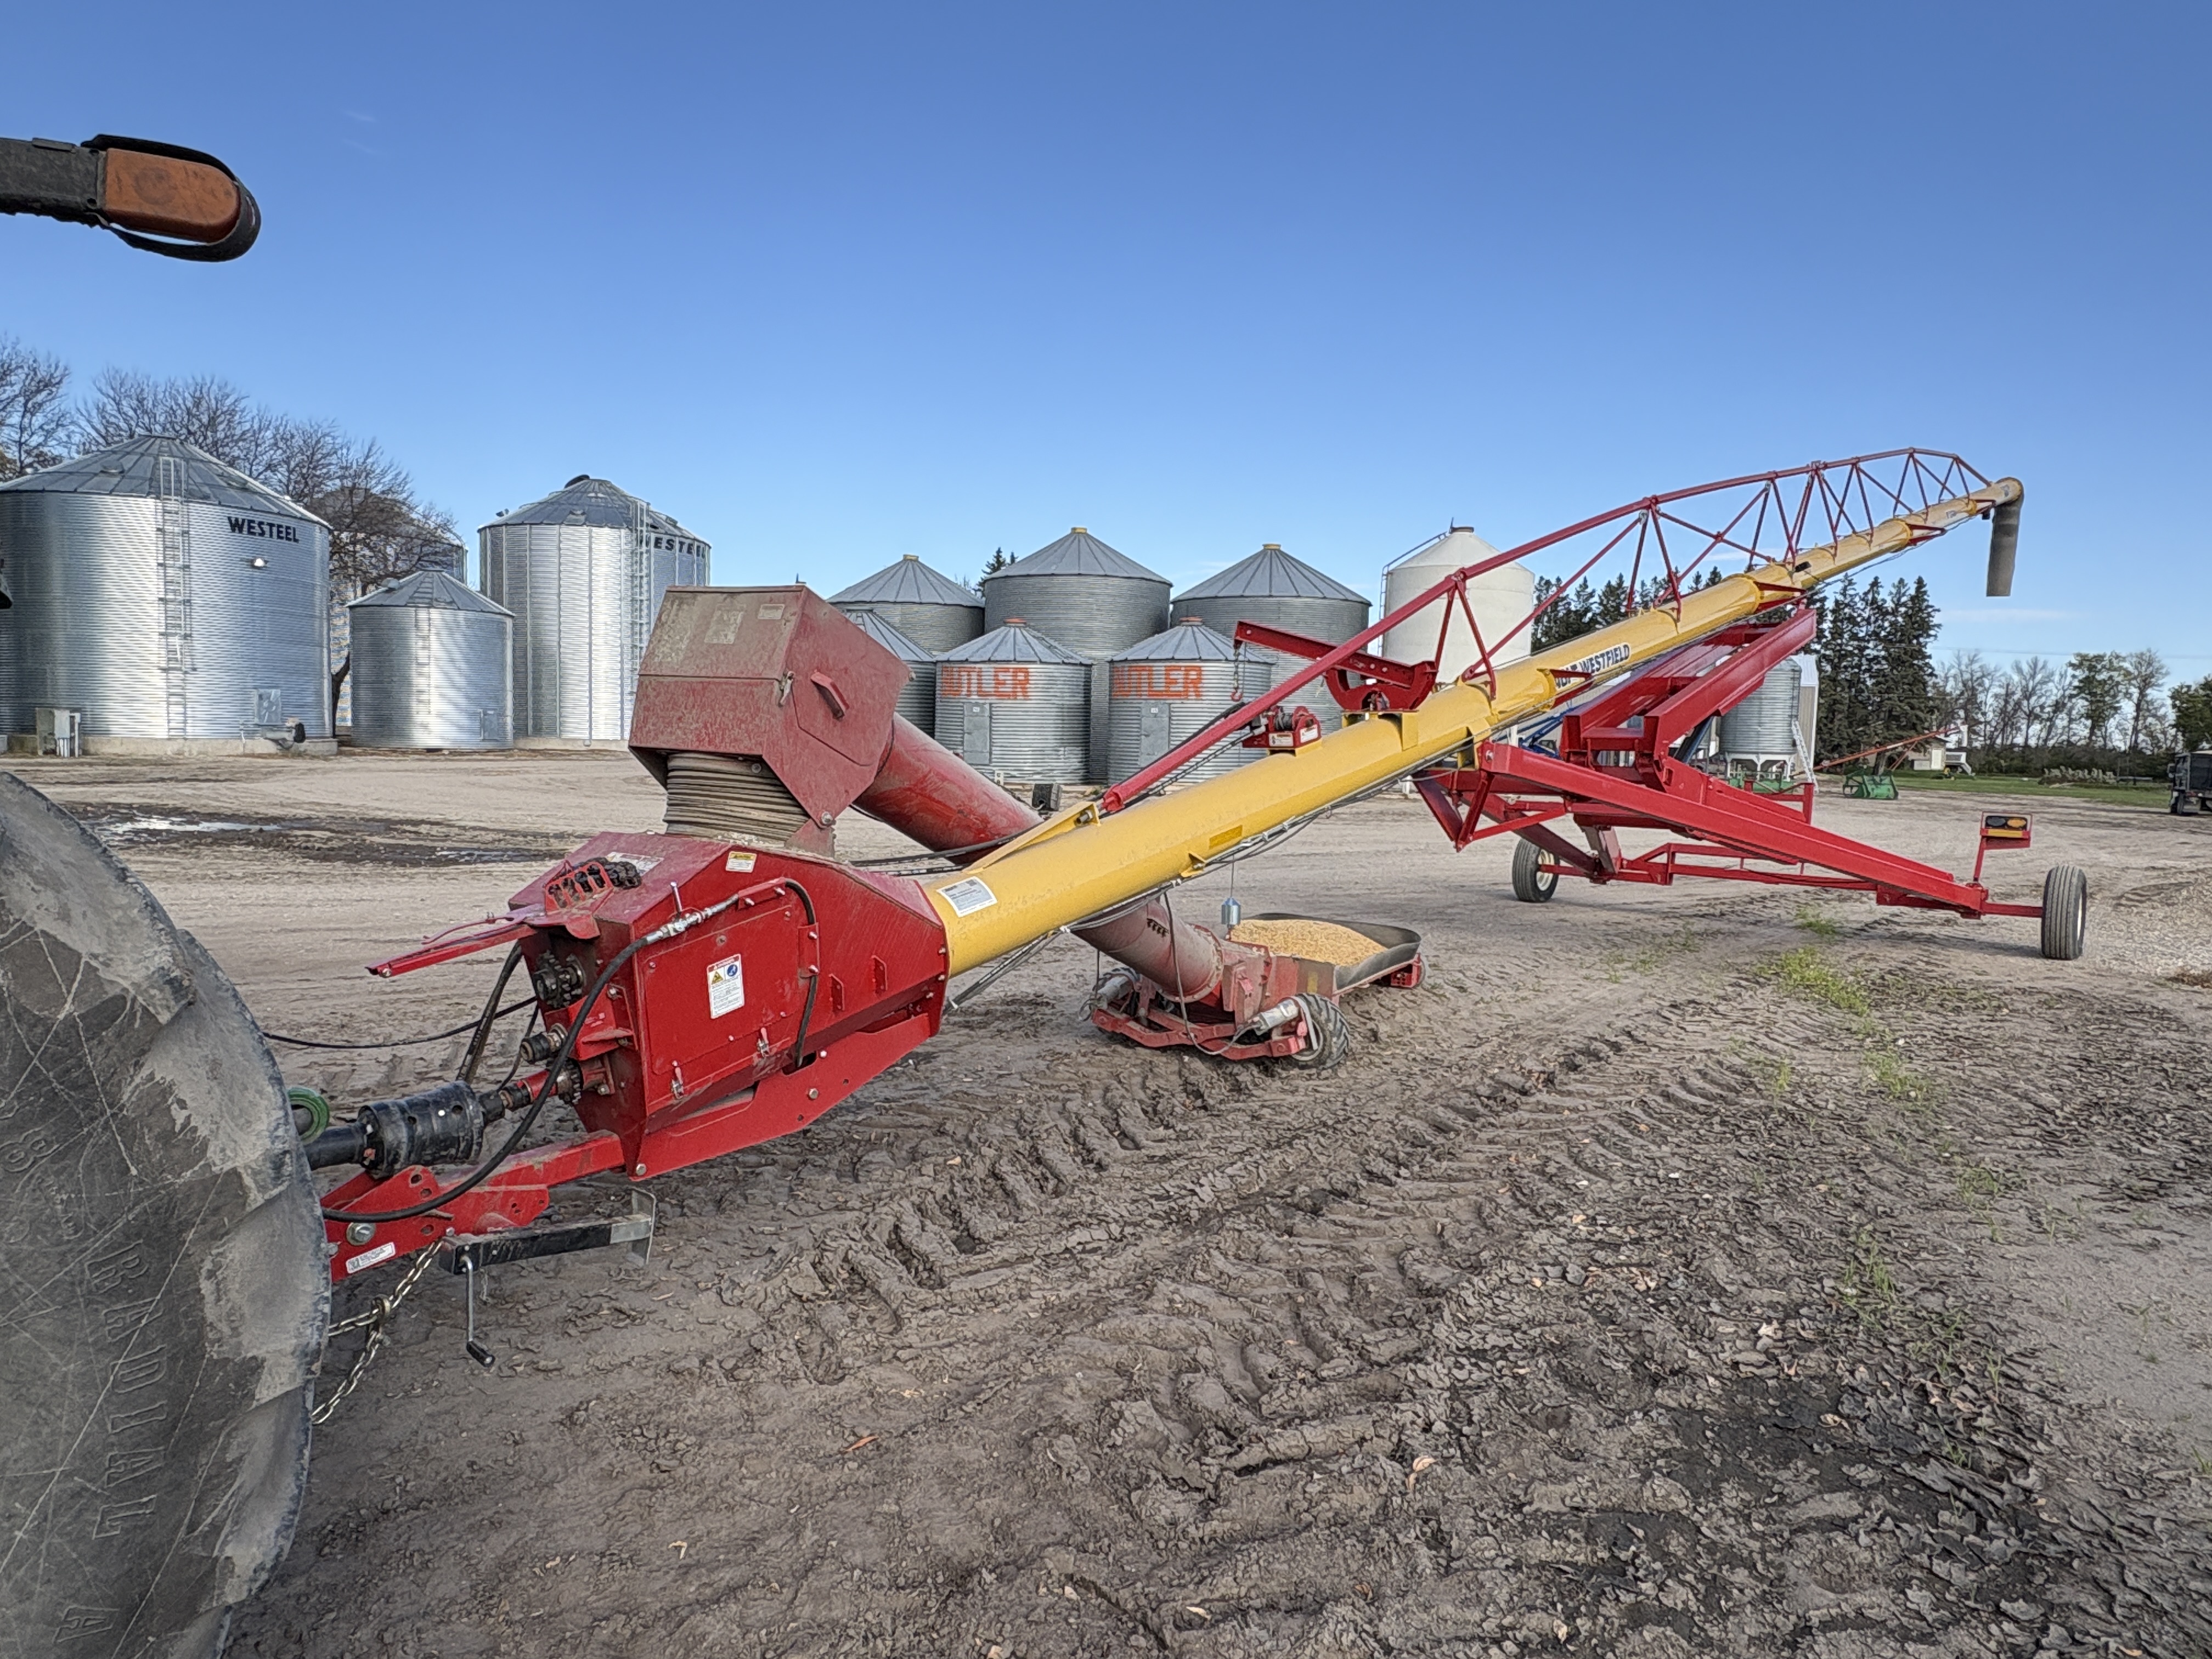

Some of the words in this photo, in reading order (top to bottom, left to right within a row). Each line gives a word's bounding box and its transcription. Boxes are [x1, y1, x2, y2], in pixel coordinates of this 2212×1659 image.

[227, 516, 300, 544] WESTEEL
[1579, 644, 1630, 674] WESTFIELD
[85, 1238, 167, 1541] RADIAL
